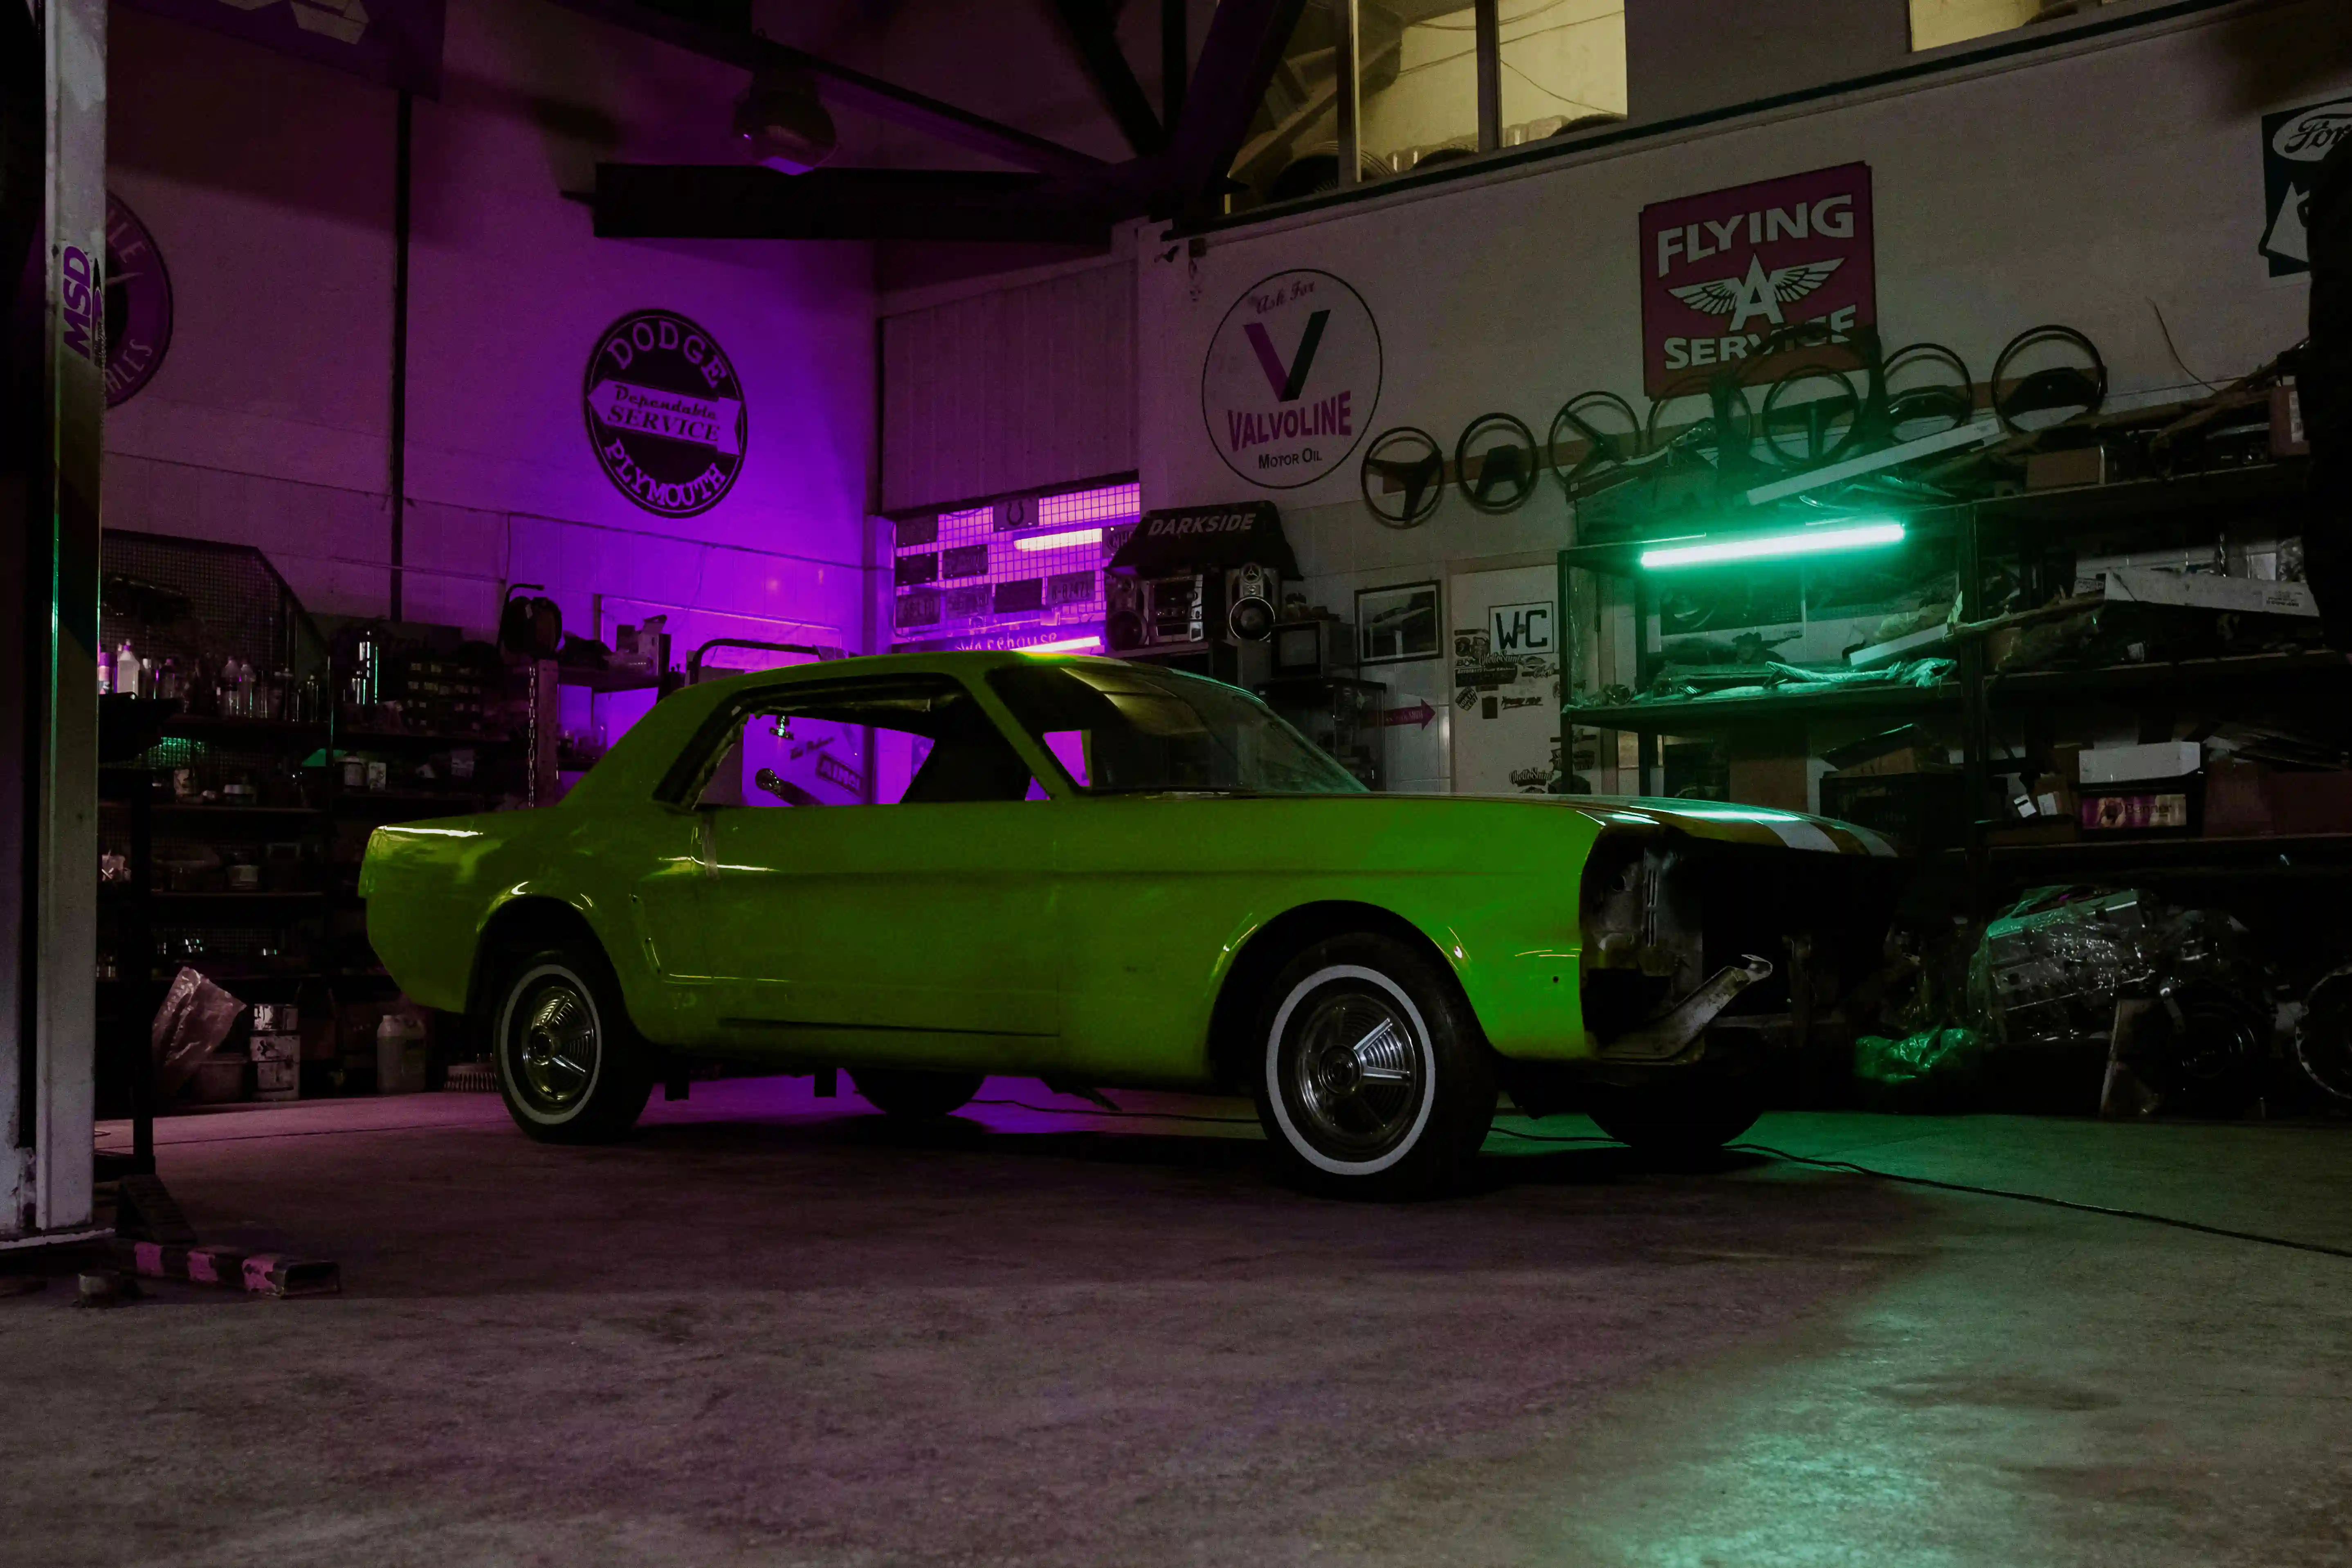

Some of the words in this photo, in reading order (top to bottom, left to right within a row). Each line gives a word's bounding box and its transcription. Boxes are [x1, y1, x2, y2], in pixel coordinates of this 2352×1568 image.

[1657, 194, 1854, 278] FLYING
[63, 246, 91, 361] MSD
[1256, 294, 1287, 314] Ask
[607, 321, 727, 389] DODGE
[607, 405, 720, 442] SERVICE
[614, 383, 717, 420] Dependable
[1228, 391, 1351, 452] VALVOLINE
[604, 438, 726, 506] PLYMOUTH
[1148, 513, 1256, 536] DARKSIDE
